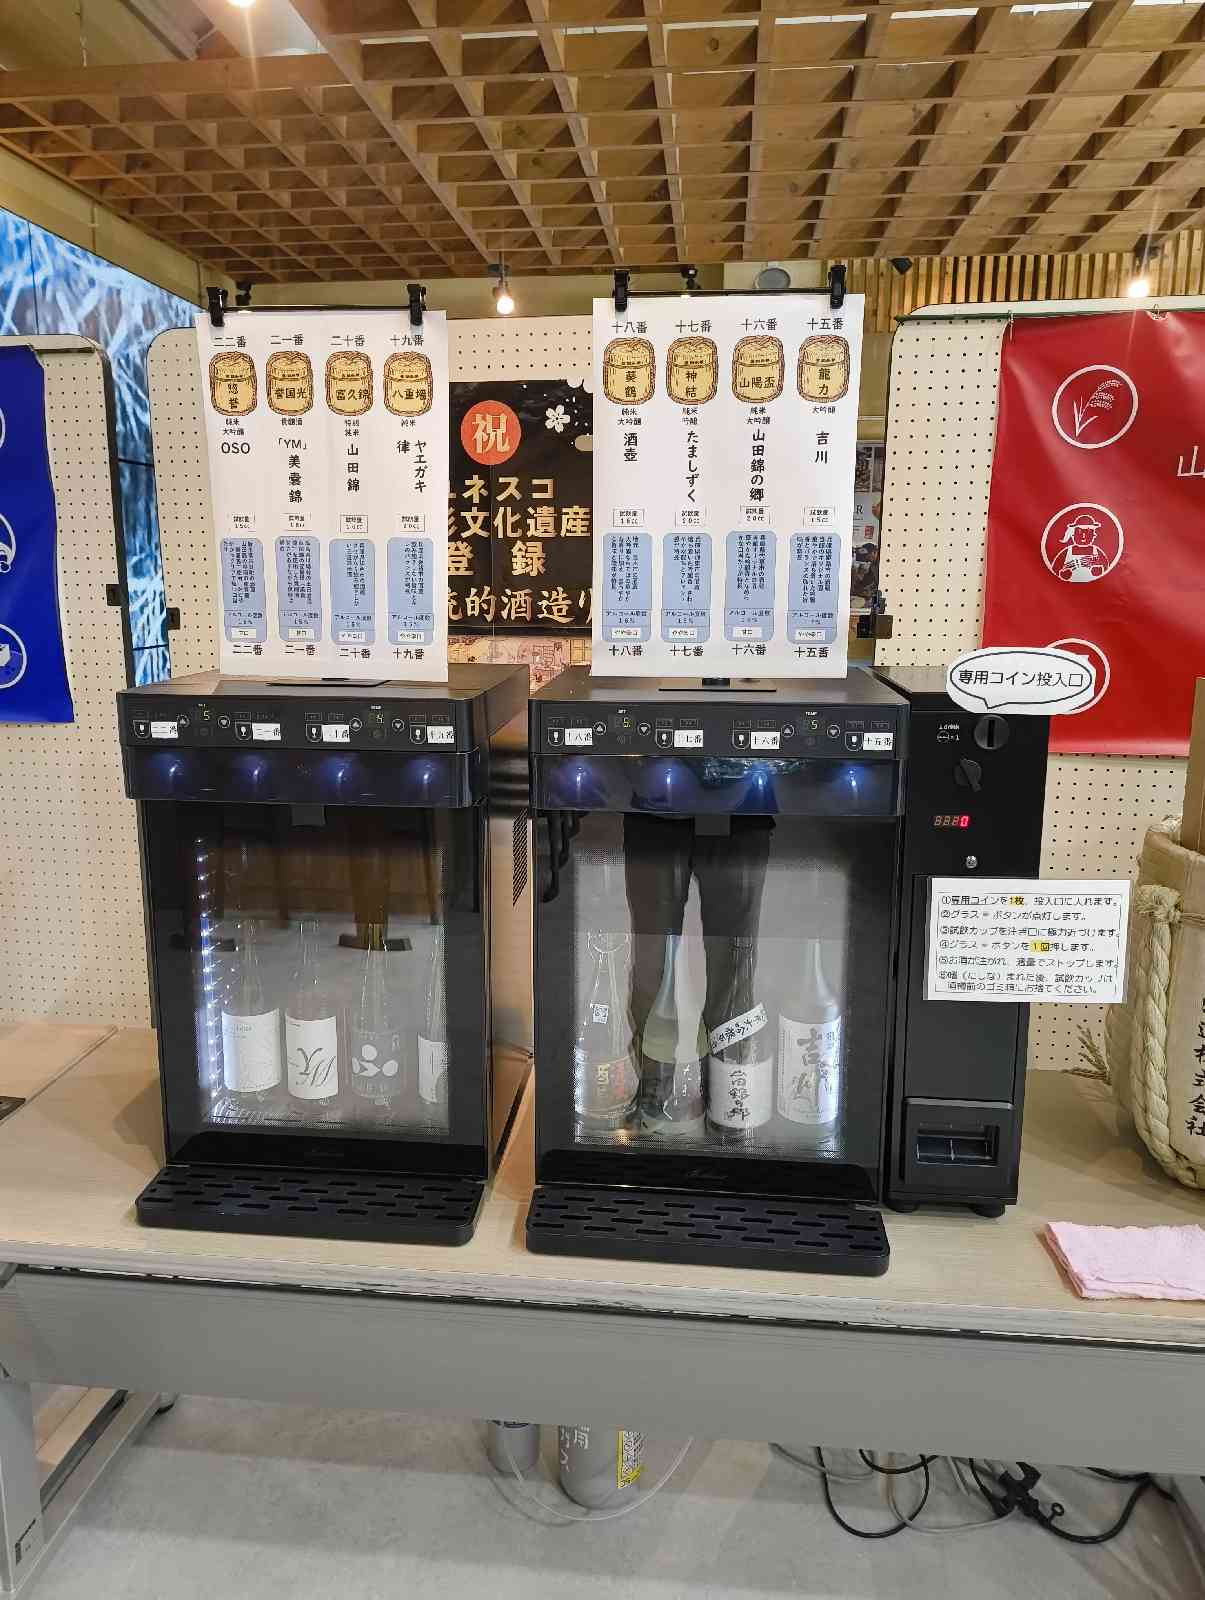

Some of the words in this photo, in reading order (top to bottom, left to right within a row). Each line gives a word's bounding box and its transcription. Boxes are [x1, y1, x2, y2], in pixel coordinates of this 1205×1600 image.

[612, 321, 648, 334] 十八番
[676, 320, 712, 333] 十七番
[740, 318, 778, 331] 十六番
[807, 318, 844, 331] 十五番
[213, 336, 247, 349] 二二番
[270, 334, 304, 346] 二一番
[330, 335, 366, 346] 二十番
[390, 334, 424, 346] 十九番
[686, 370, 698, 398] 神結
[740, 376, 776, 390] 山陽盃
[818, 368, 830, 394] 龍力
[621, 408, 638, 416] 純米
[750, 407, 766, 416] 純米
[812, 406, 836, 415] 大吟醸
[617, 417, 642, 426] 大吟醸
[746, 416, 770, 426] 大吟醸
[472, 412, 511, 454] 祝
[220, 442, 251, 454] OSO
[396, 440, 411, 454] 律
[815, 430, 830, 464] 吉川
[346, 444, 360, 492] 山田錦
[414, 439, 428, 493] ヤエガキ
[686, 430, 699, 503] たましずく
[749, 429, 765, 502] 山田錦の郷
[233, 644, 263, 656] 二二番
[286, 644, 315, 656] 二一番
[339, 648, 371, 659] 二十番
[393, 648, 425, 660] 十九番
[609, 645, 644, 656] 十八番
[670, 645, 704, 657] 十七番
[732, 644, 767, 656] 十六番
[794, 646, 828, 658] 十五番
[958, 670, 1084, 688] 専用コイン投入口
